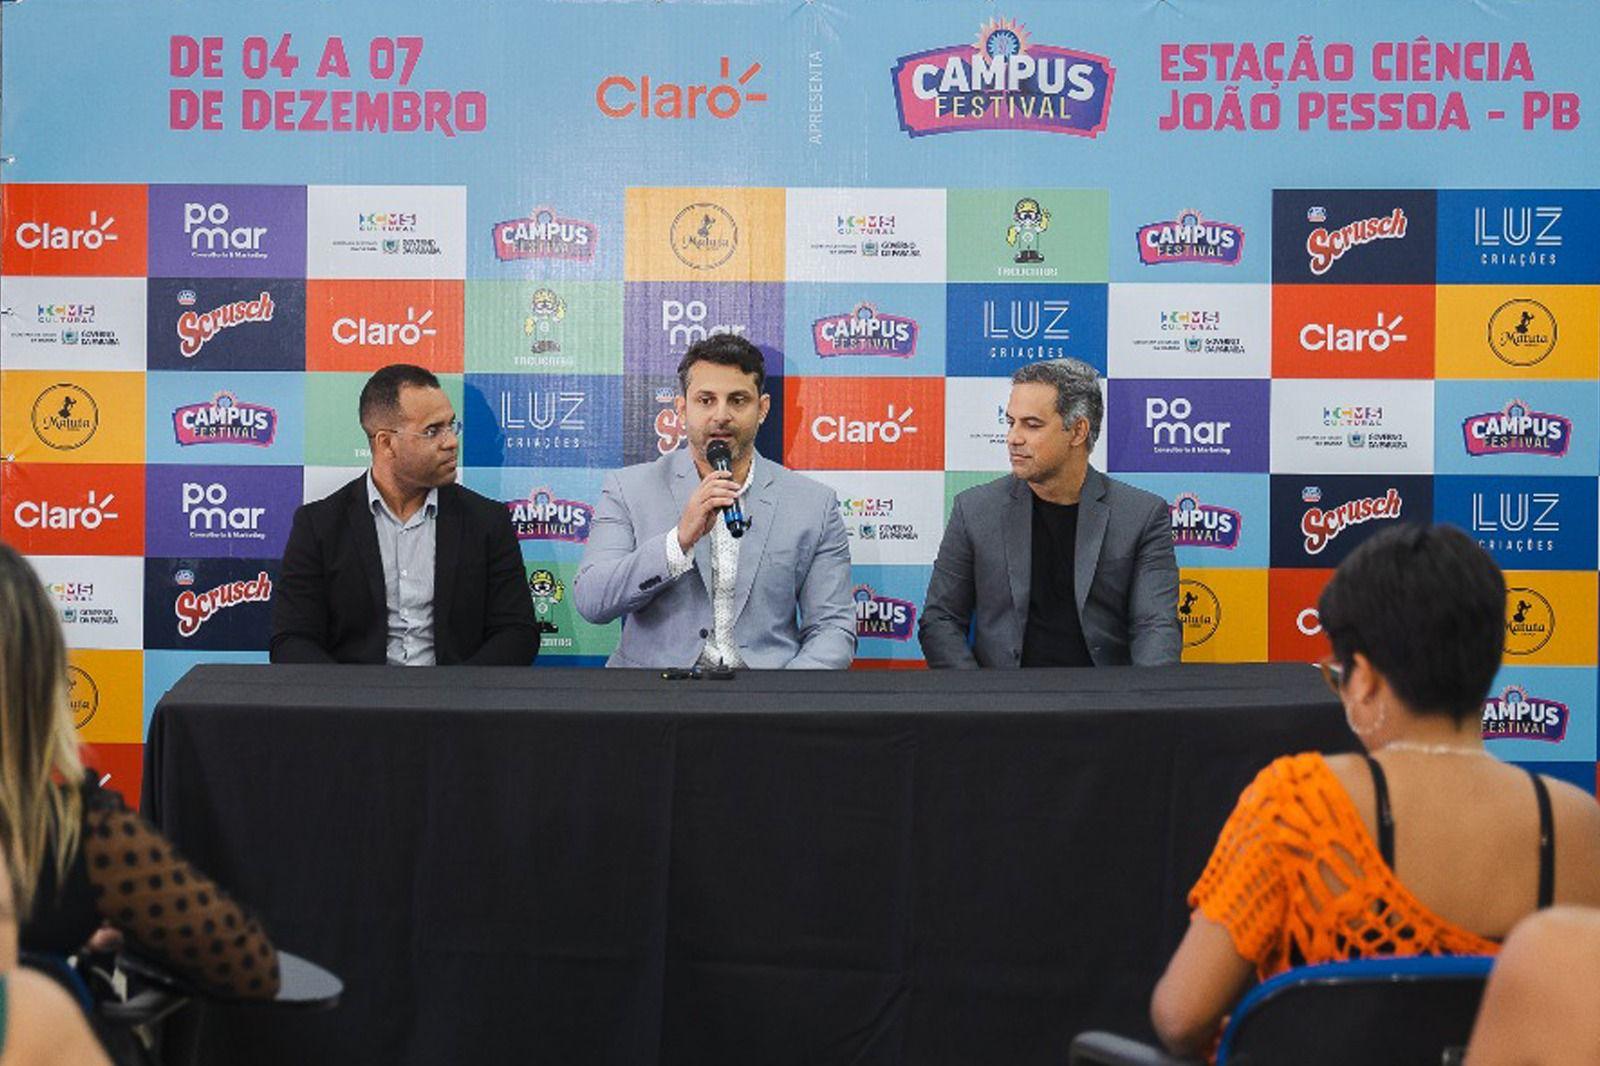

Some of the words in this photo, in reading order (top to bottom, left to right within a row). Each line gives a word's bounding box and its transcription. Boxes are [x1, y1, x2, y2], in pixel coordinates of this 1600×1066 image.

[169, 35, 224, 78] DE
[242, 33, 299, 79] 04
[315, 36, 351, 78] A
[370, 36, 424, 86] 07
[1160, 35, 1354, 89] ESTAÇÃO
[1372, 35, 1535, 81] CIÊNCIA
[912, 54, 1095, 101] CAMPUS
[596, 75, 741, 119] Claro
[808, 50, 823, 145] APRESENTA
[934, 96, 1072, 118] FESTIVAL
[1159, 85, 1281, 130] JOÃO
[1298, 91, 1471, 130] PESSOA
[1523, 91, 1581, 130] PB
[169, 89, 224, 130] DE
[242, 88, 487, 137] DEZEMBRO
[184, 203, 229, 233] po
[1475, 207, 1563, 246] LUZ
[16, 222, 103, 249] Claro
[192, 227, 267, 249] mar
[502, 222, 588, 245] CAMPUS
[1146, 226, 1235, 249] CAMPUS
[1307, 207, 1408, 275] Scrusch
[1156, 245, 1223, 257] FESTIVAL
[177, 292, 275, 357] Scrusch
[662, 301, 707, 330] po
[984, 301, 1070, 339] LUZ
[332, 318, 421, 345] Claro
[822, 319, 910, 342] CAMPUS
[832, 338, 898, 350] FESTIVAL
[1300, 324, 1390, 351] Claro
[182, 406, 269, 430] CAMPUS
[501, 392, 585, 430] LUZ
[1146, 398, 1192, 428] po
[194, 427, 258, 439] FESTIVAL
[811, 416, 901, 442] Claro
[1154, 422, 1231, 444] mar
[1472, 416, 1562, 440] CAMPUS
[1484, 435, 1550, 448] FESTIVAL
[182, 483, 227, 513] po
[14, 501, 102, 529] Claro
[190, 507, 265, 529] mar
[511, 503, 587, 527] AMPUS
[1171, 509, 1232, 533] MPUS
[1301, 488, 1402, 555] Scrusch
[1473, 493, 1559, 531] LUZ
[1171, 529, 1221, 542] STIVAL
[175, 569, 272, 637] Scrusch
[856, 600, 906, 624] PUS
[856, 619, 895, 632] TIVAL
[1482, 702, 1560, 725] AMPUS
